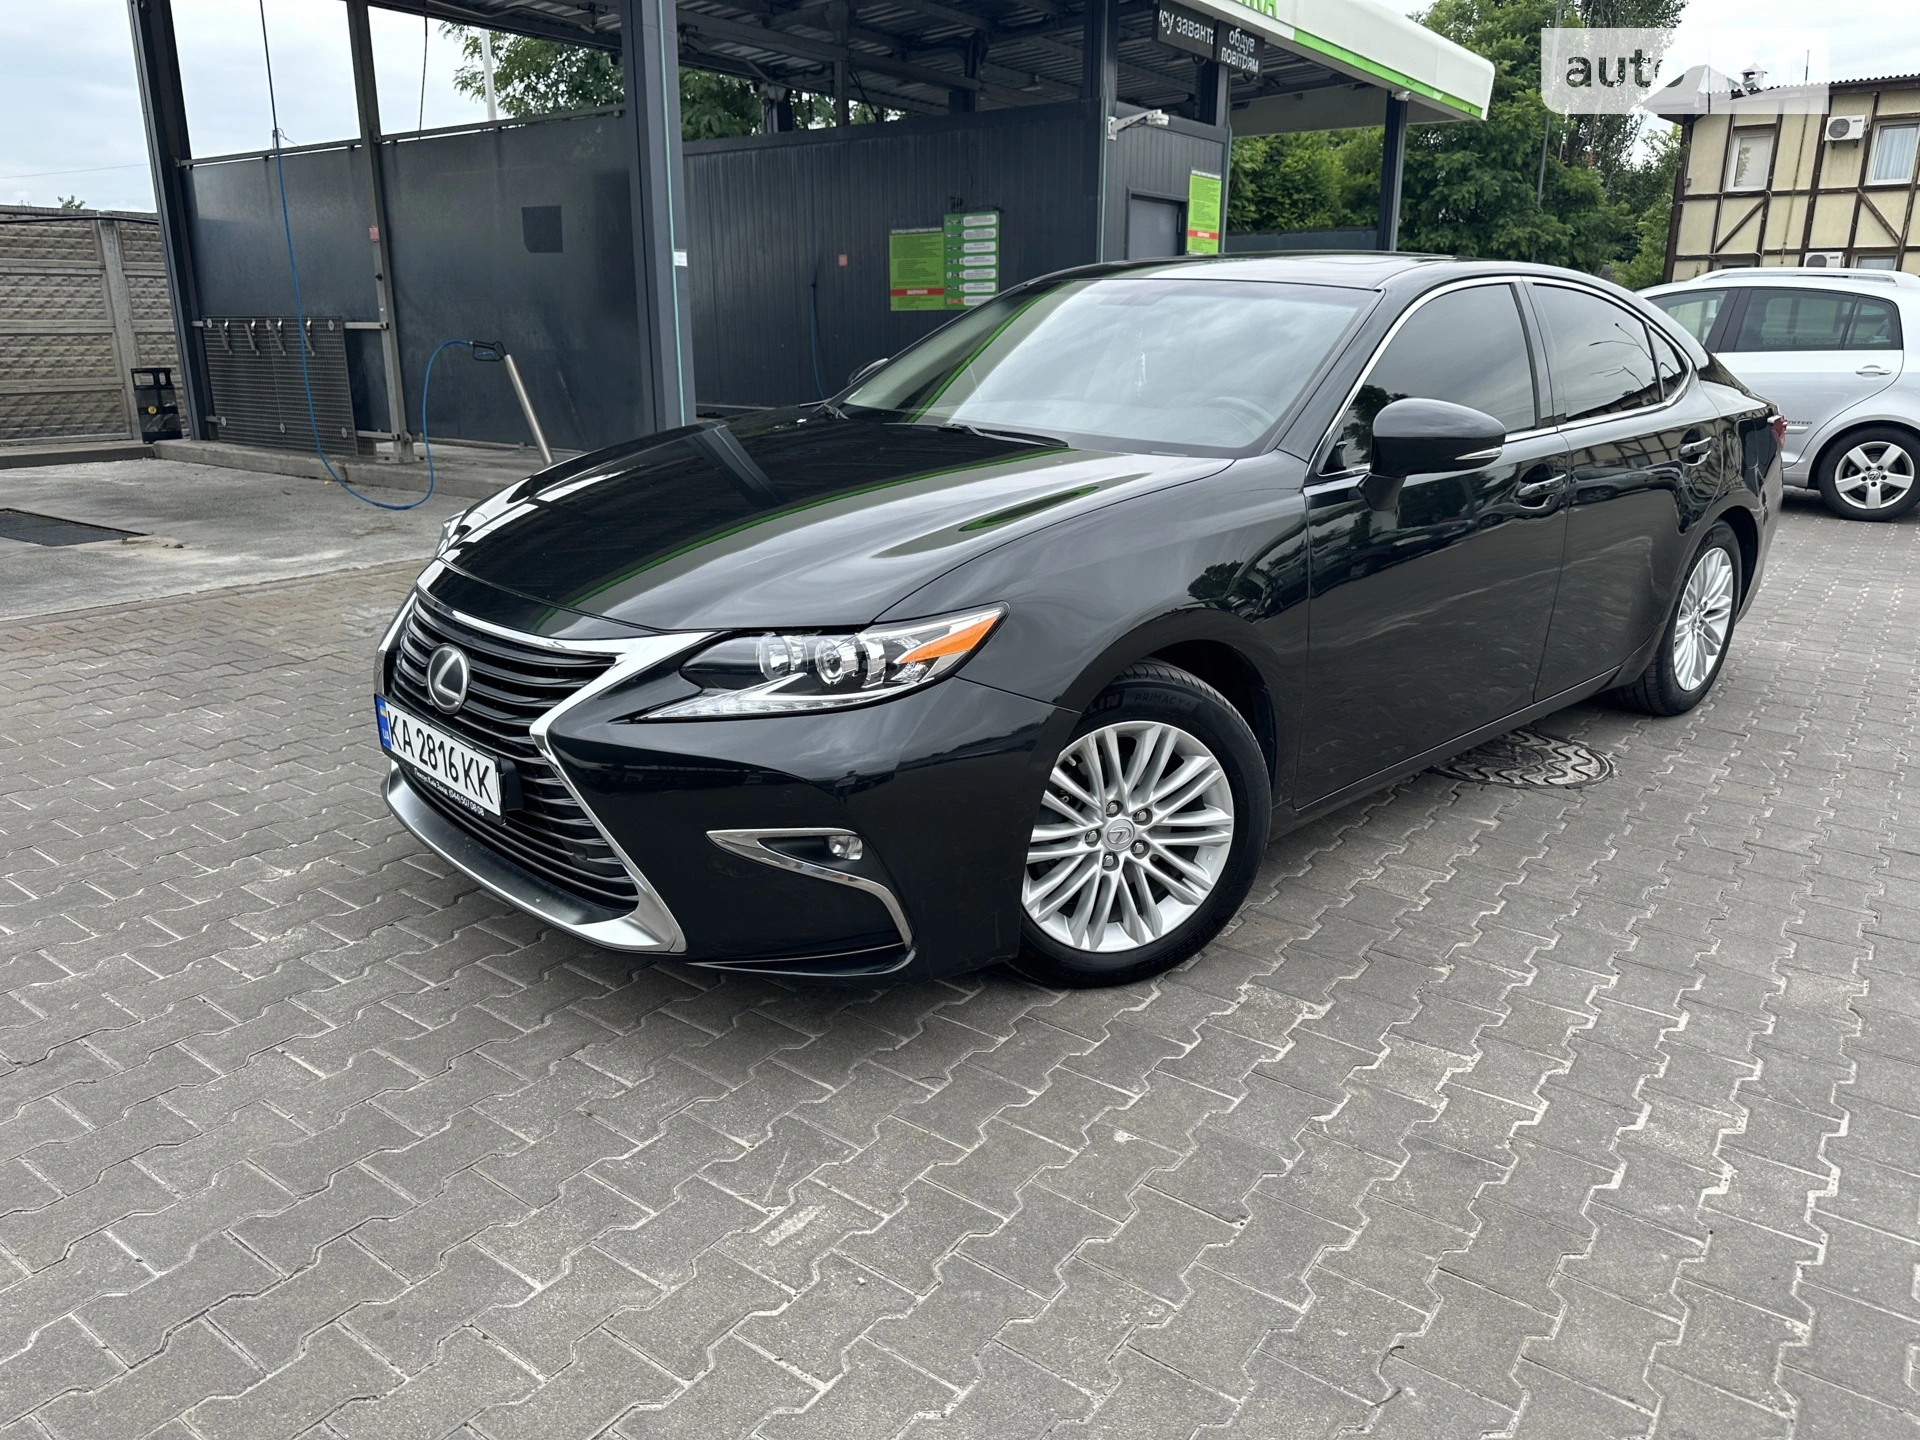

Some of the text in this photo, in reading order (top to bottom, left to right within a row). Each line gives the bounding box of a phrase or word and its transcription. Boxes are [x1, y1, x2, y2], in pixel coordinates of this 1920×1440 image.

[1221, 47, 1259, 73] повітрям
[1134, 692, 1184, 707] PRIMACY
[387, 710, 494, 805] KA 2816 KK
